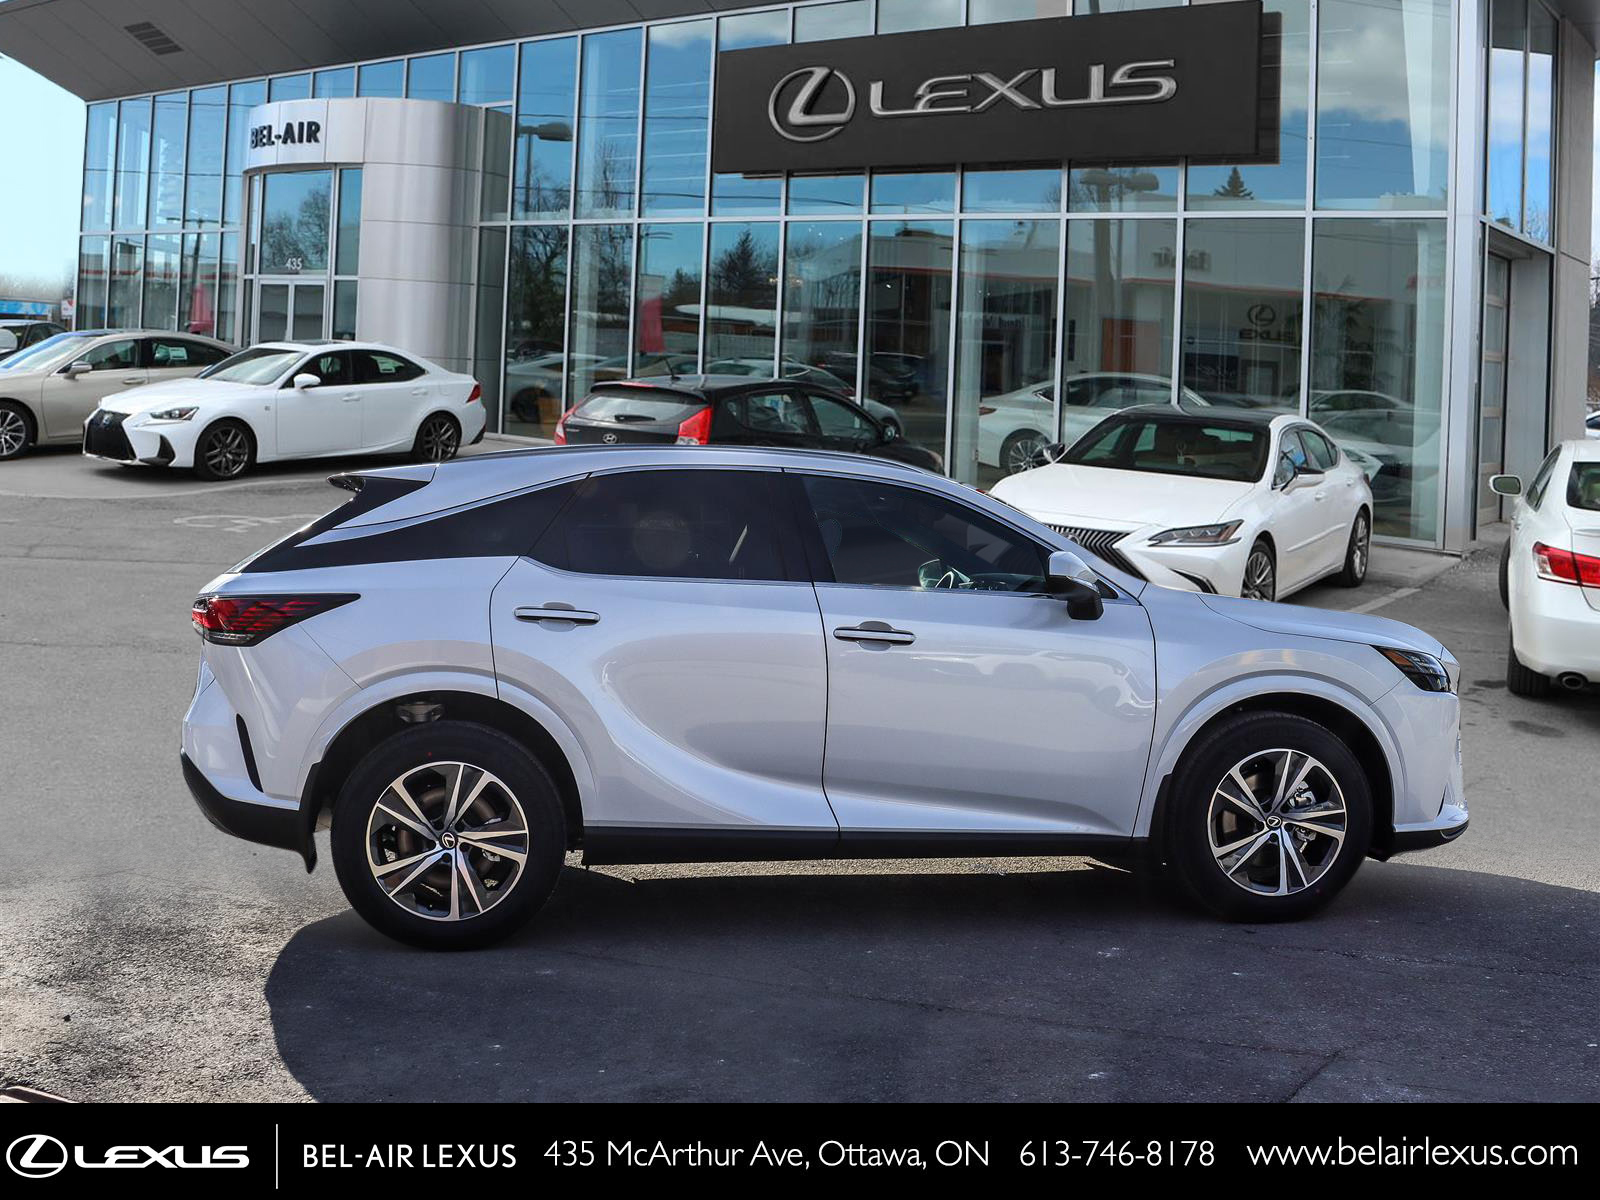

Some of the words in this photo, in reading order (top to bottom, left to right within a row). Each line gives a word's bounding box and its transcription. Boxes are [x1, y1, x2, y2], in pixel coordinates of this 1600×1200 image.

[870, 59, 1177, 118] LEXUS
[250, 120, 321, 149] BEL-AIR
[285, 257, 303, 270] 435
